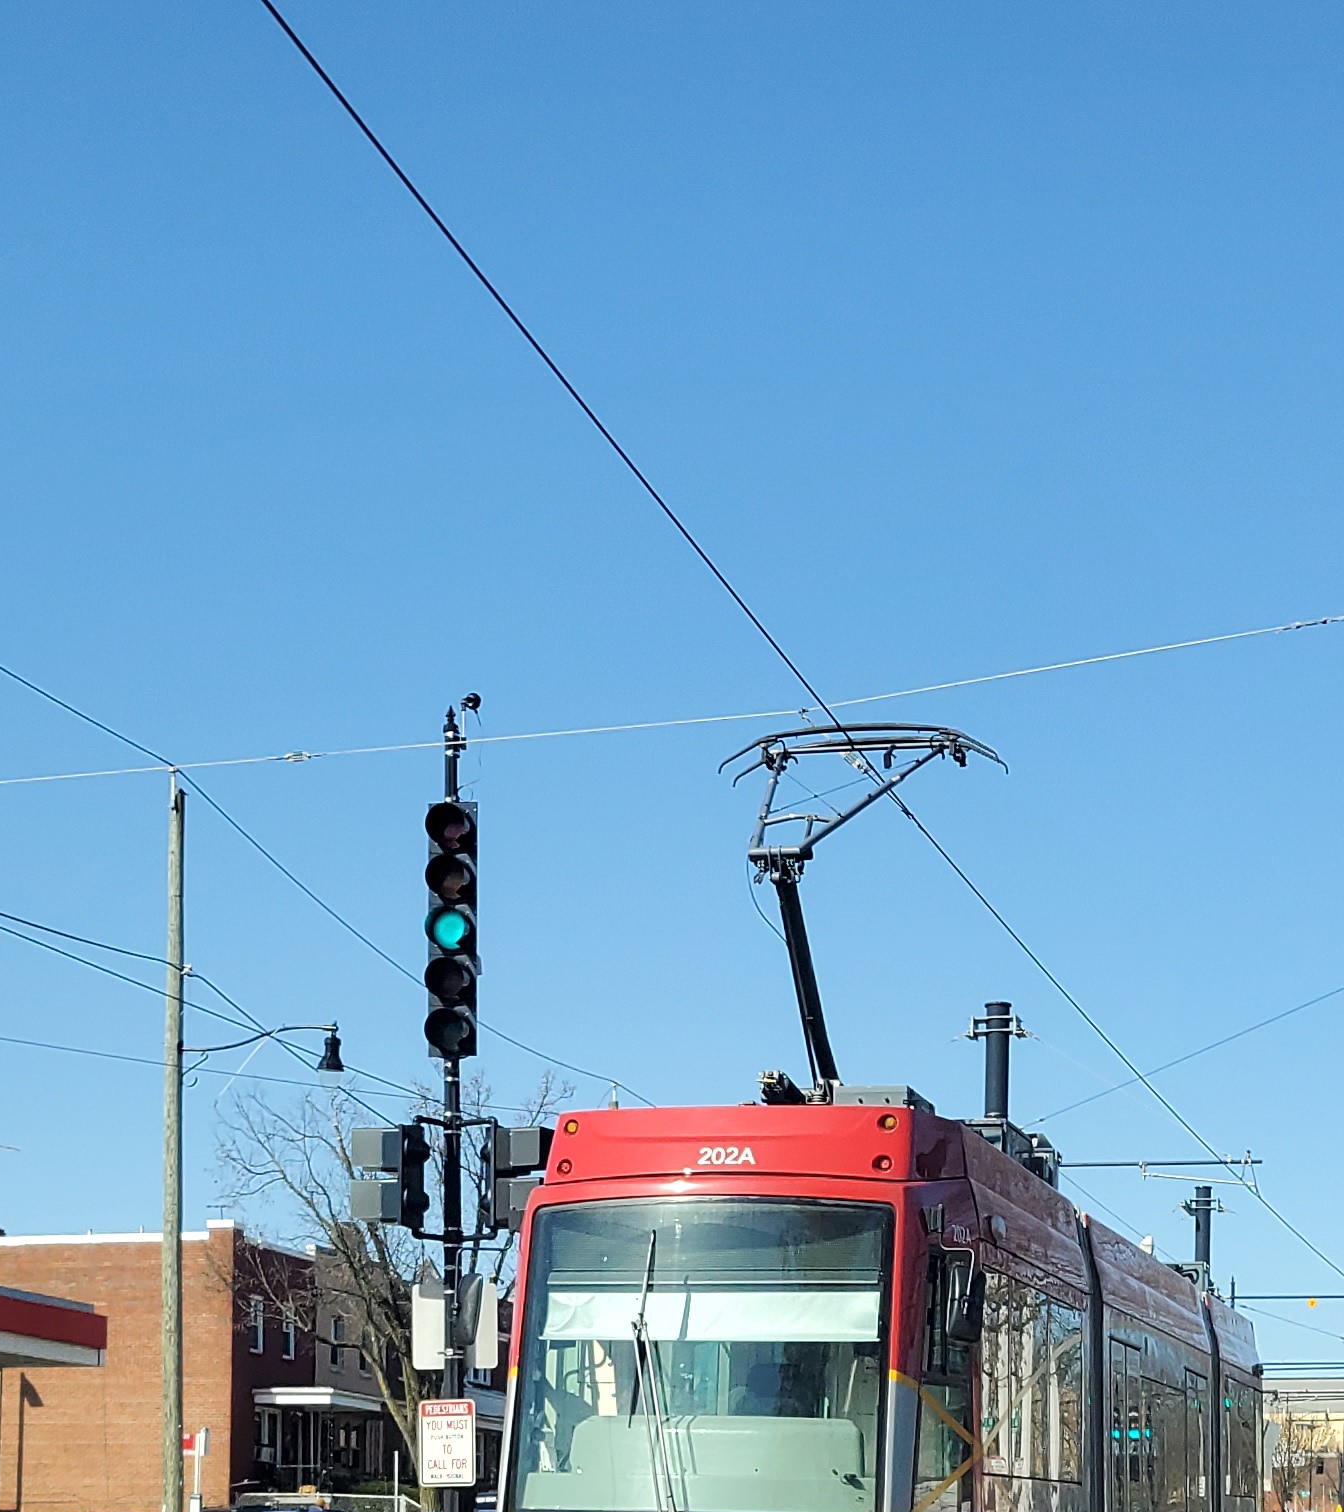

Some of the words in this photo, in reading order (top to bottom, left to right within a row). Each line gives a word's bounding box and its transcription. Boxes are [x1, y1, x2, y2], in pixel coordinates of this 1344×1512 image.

[697, 1146, 756, 1165] 202A
[426, 1420, 443, 1430] YOU
[447, 1419, 468, 1430] MUST
[443, 1444, 453, 1455] TO
[427, 1459, 447, 1470] CALL
[451, 1458, 468, 1470] FOR
